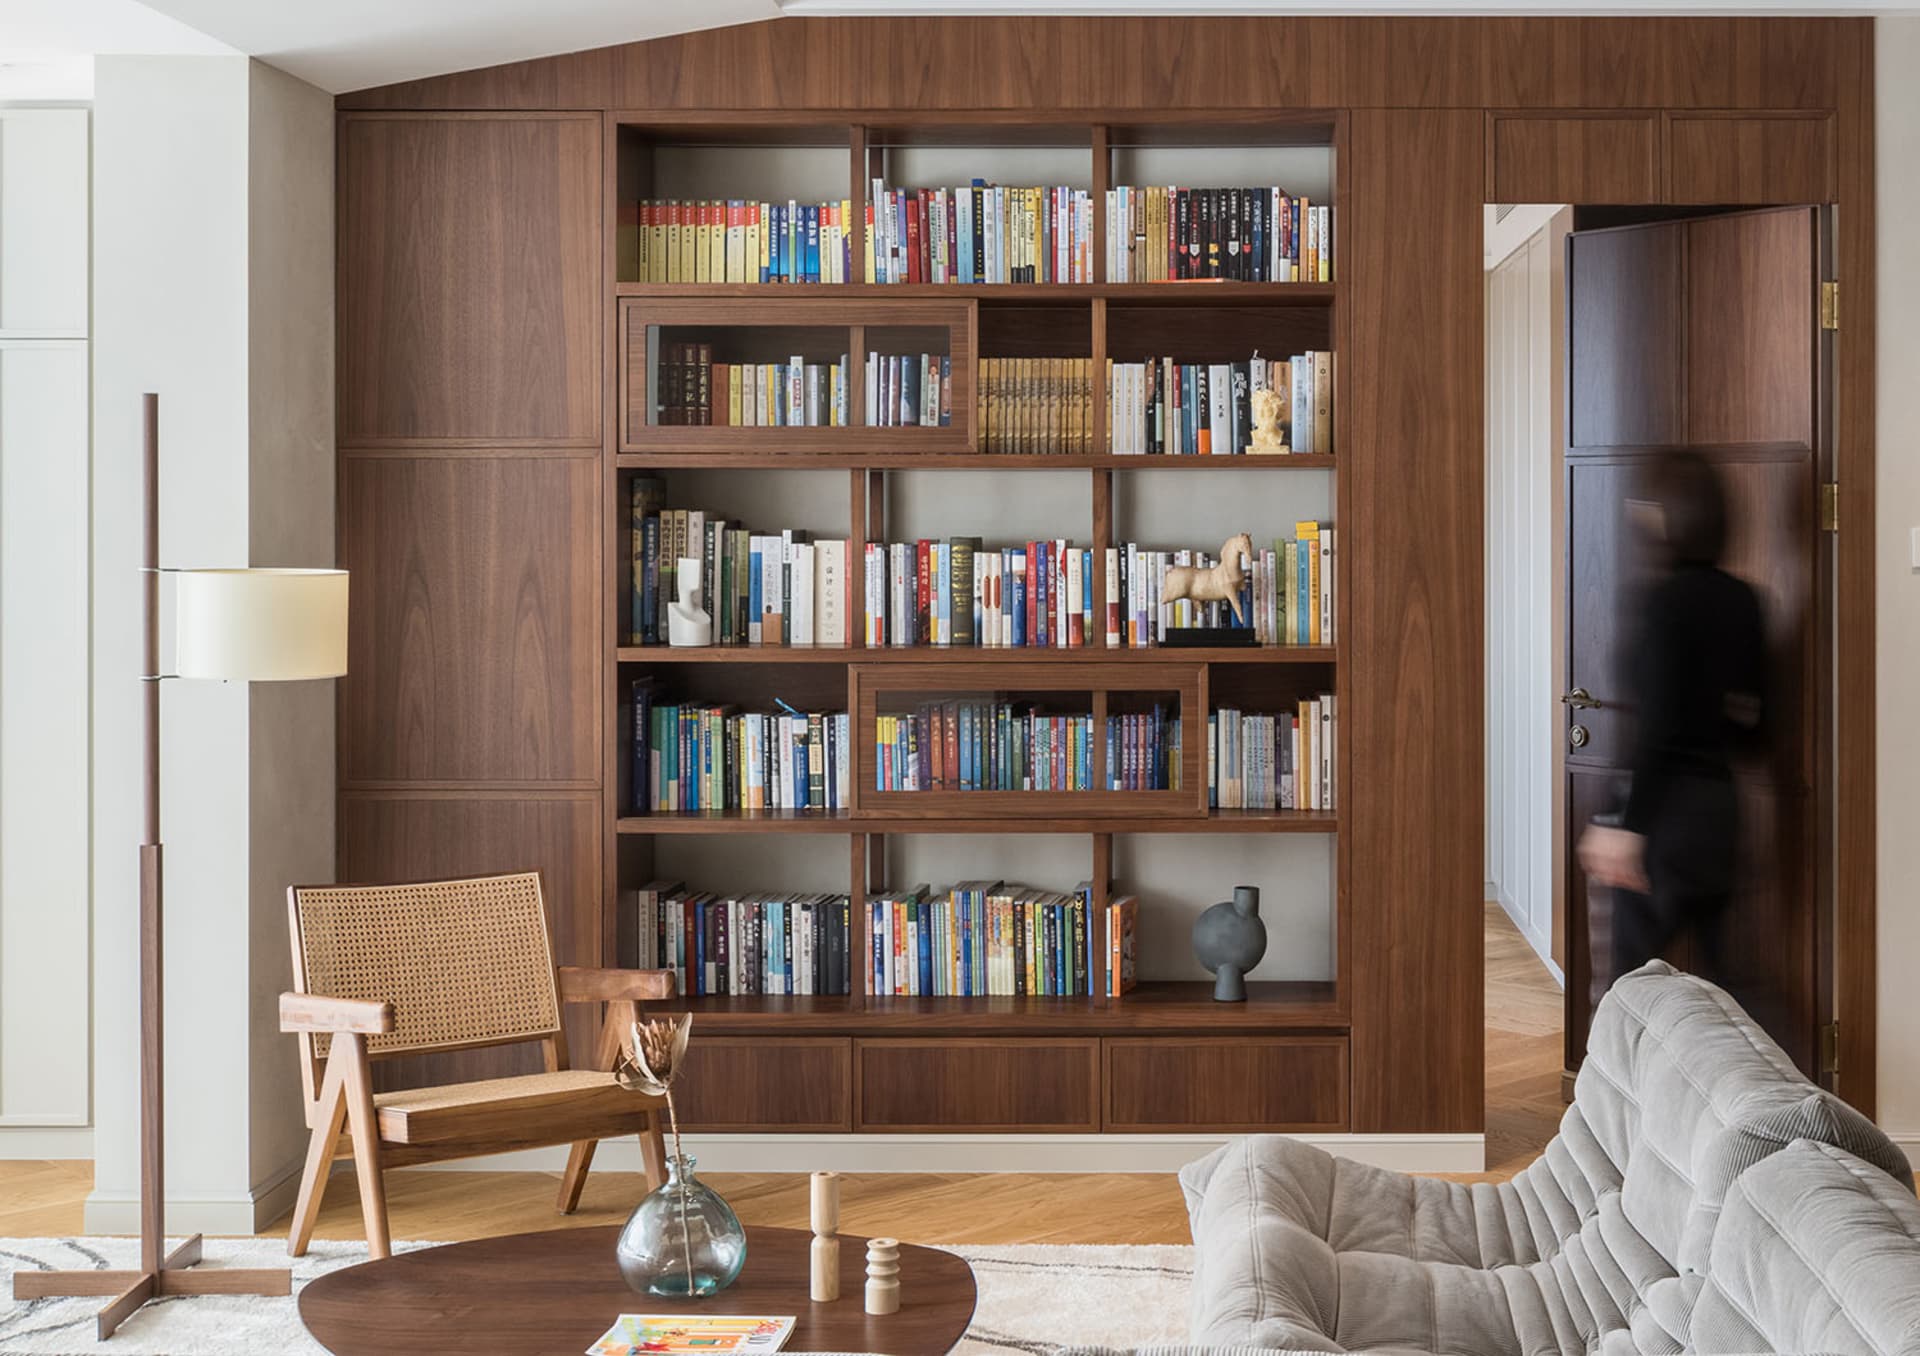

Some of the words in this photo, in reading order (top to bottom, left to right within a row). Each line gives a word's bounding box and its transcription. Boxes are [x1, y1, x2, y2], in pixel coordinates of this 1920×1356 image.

[675, 519, 685, 559] 室内设计资料
